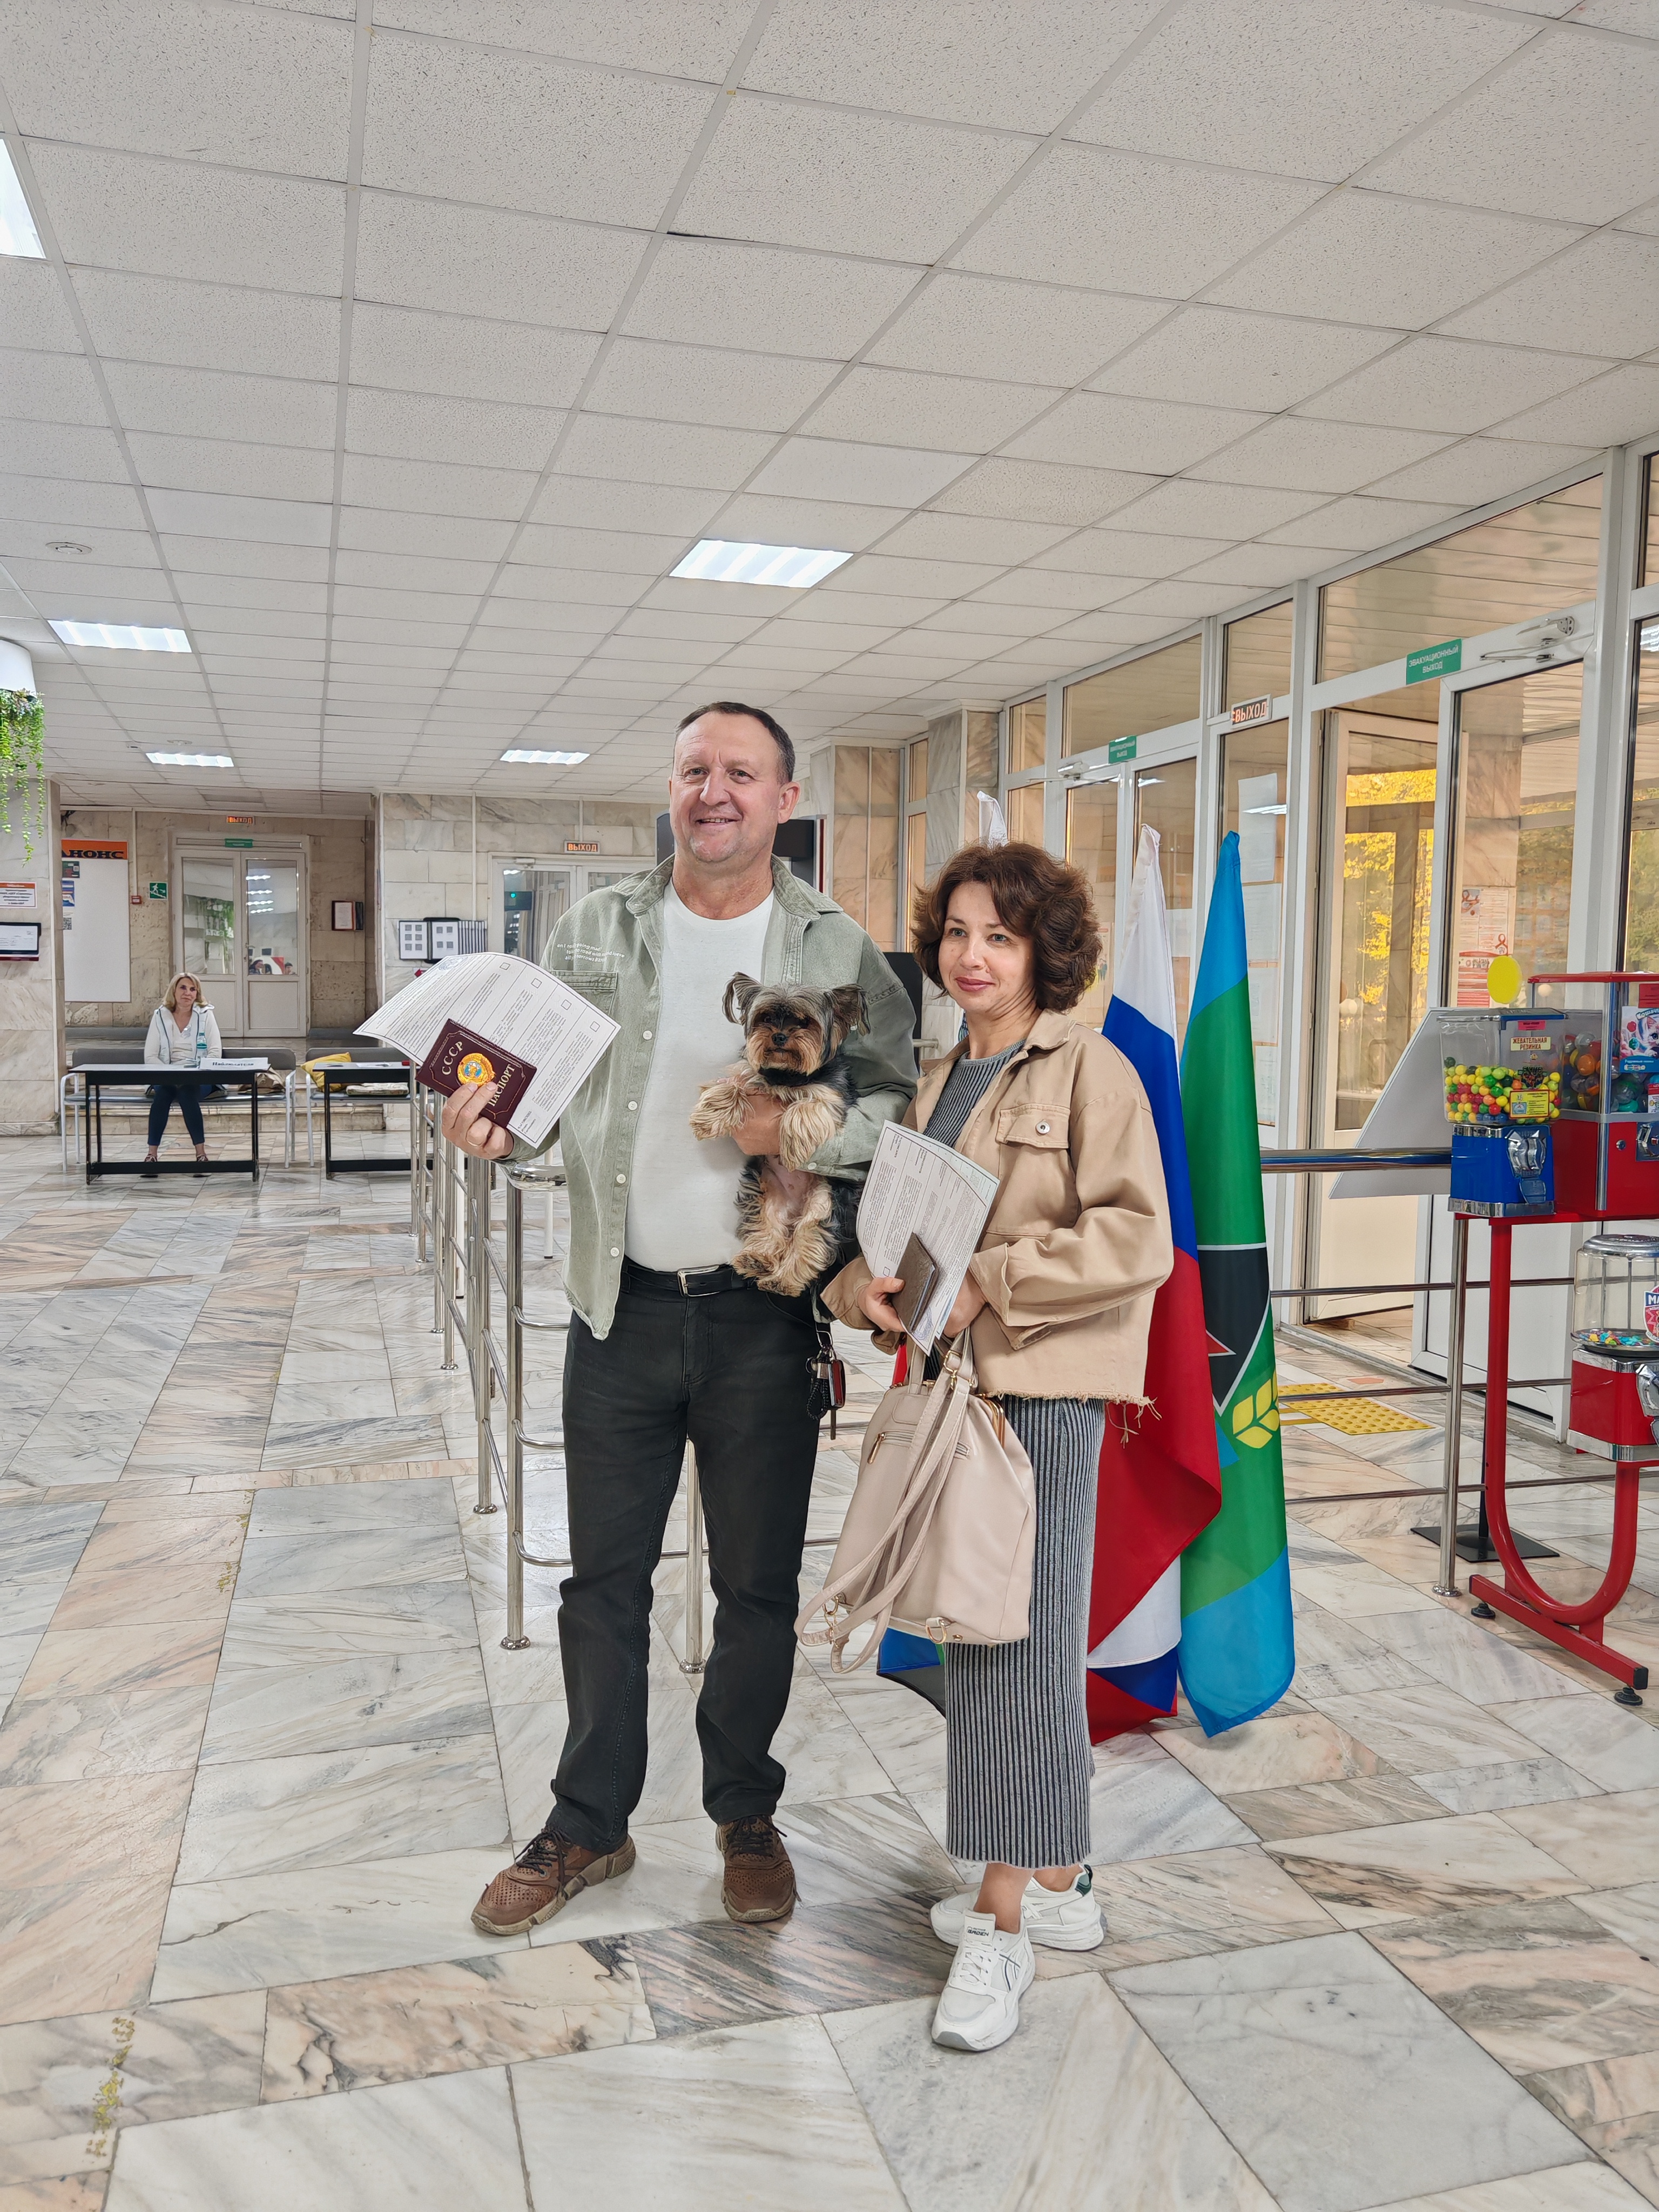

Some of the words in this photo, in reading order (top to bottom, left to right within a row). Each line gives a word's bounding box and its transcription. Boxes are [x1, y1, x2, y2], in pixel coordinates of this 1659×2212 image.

[1422, 660, 1443, 673] ВЫХОД
[1235, 701, 1267, 723] ВЫХОД
[568, 843, 597, 852] ВЫХОД
[442, 1041, 463, 1075] СССР
[488, 1064, 515, 1107] ПАСПОРТ
